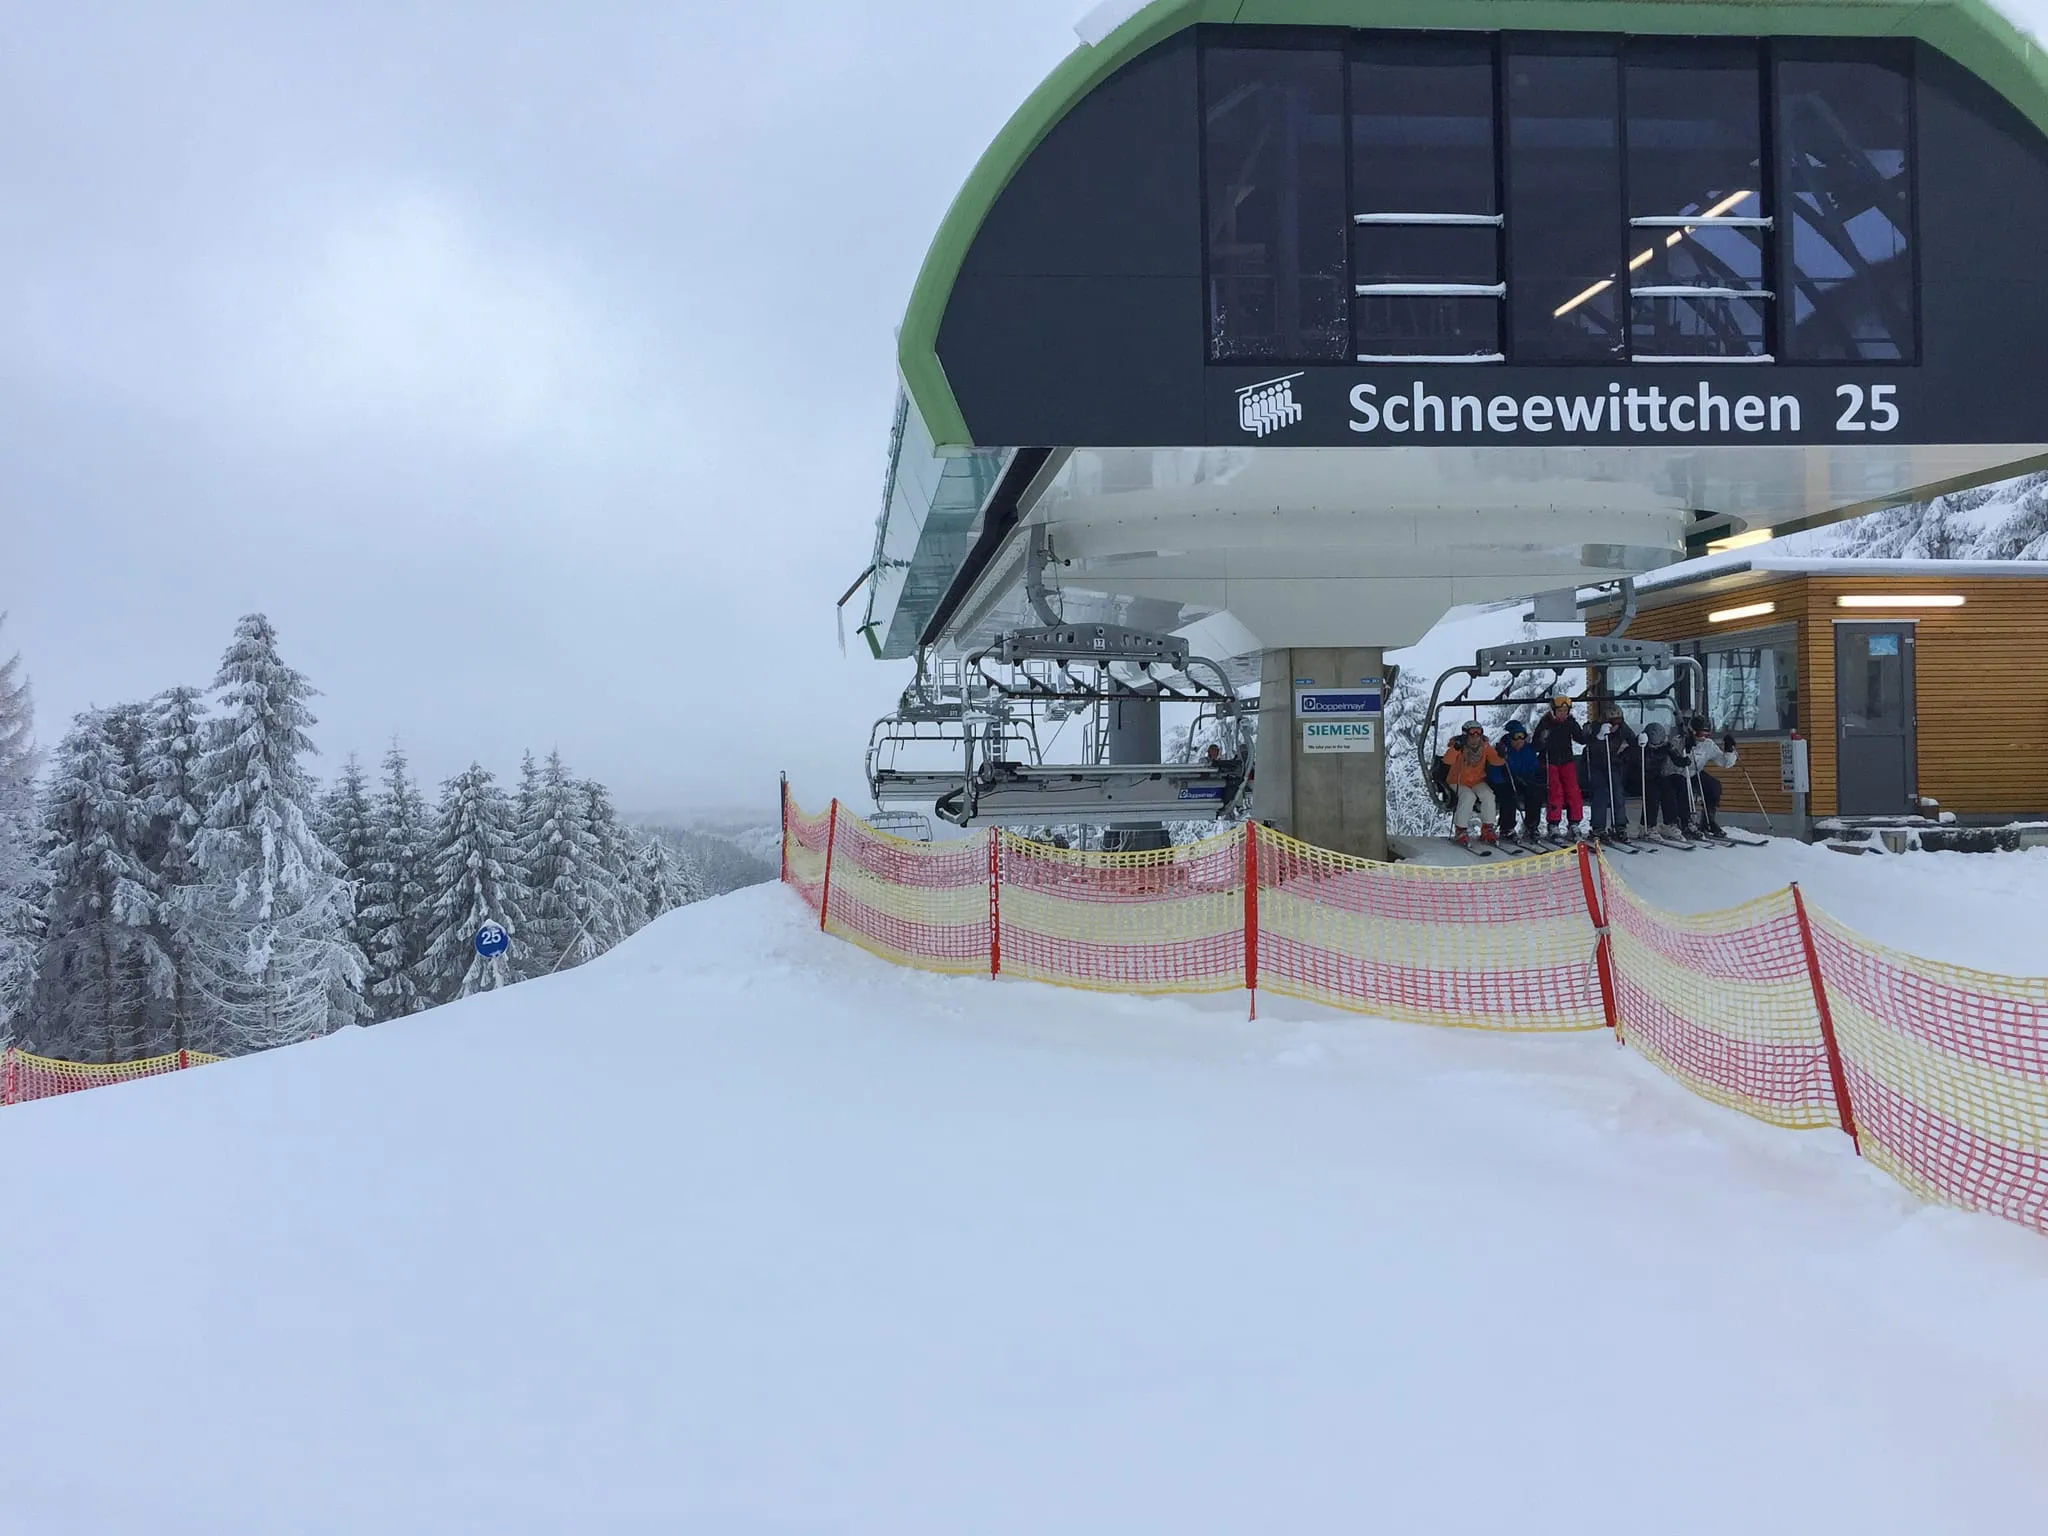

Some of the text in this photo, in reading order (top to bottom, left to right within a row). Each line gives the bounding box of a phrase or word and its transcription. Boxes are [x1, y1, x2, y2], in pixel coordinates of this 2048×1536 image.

[1349, 380, 1900, 433] Schneewittchen 25
[1315, 701, 1366, 711] Doppelmayr
[1308, 724, 1370, 736] SIEMENS
[481, 930, 502, 945] 25
